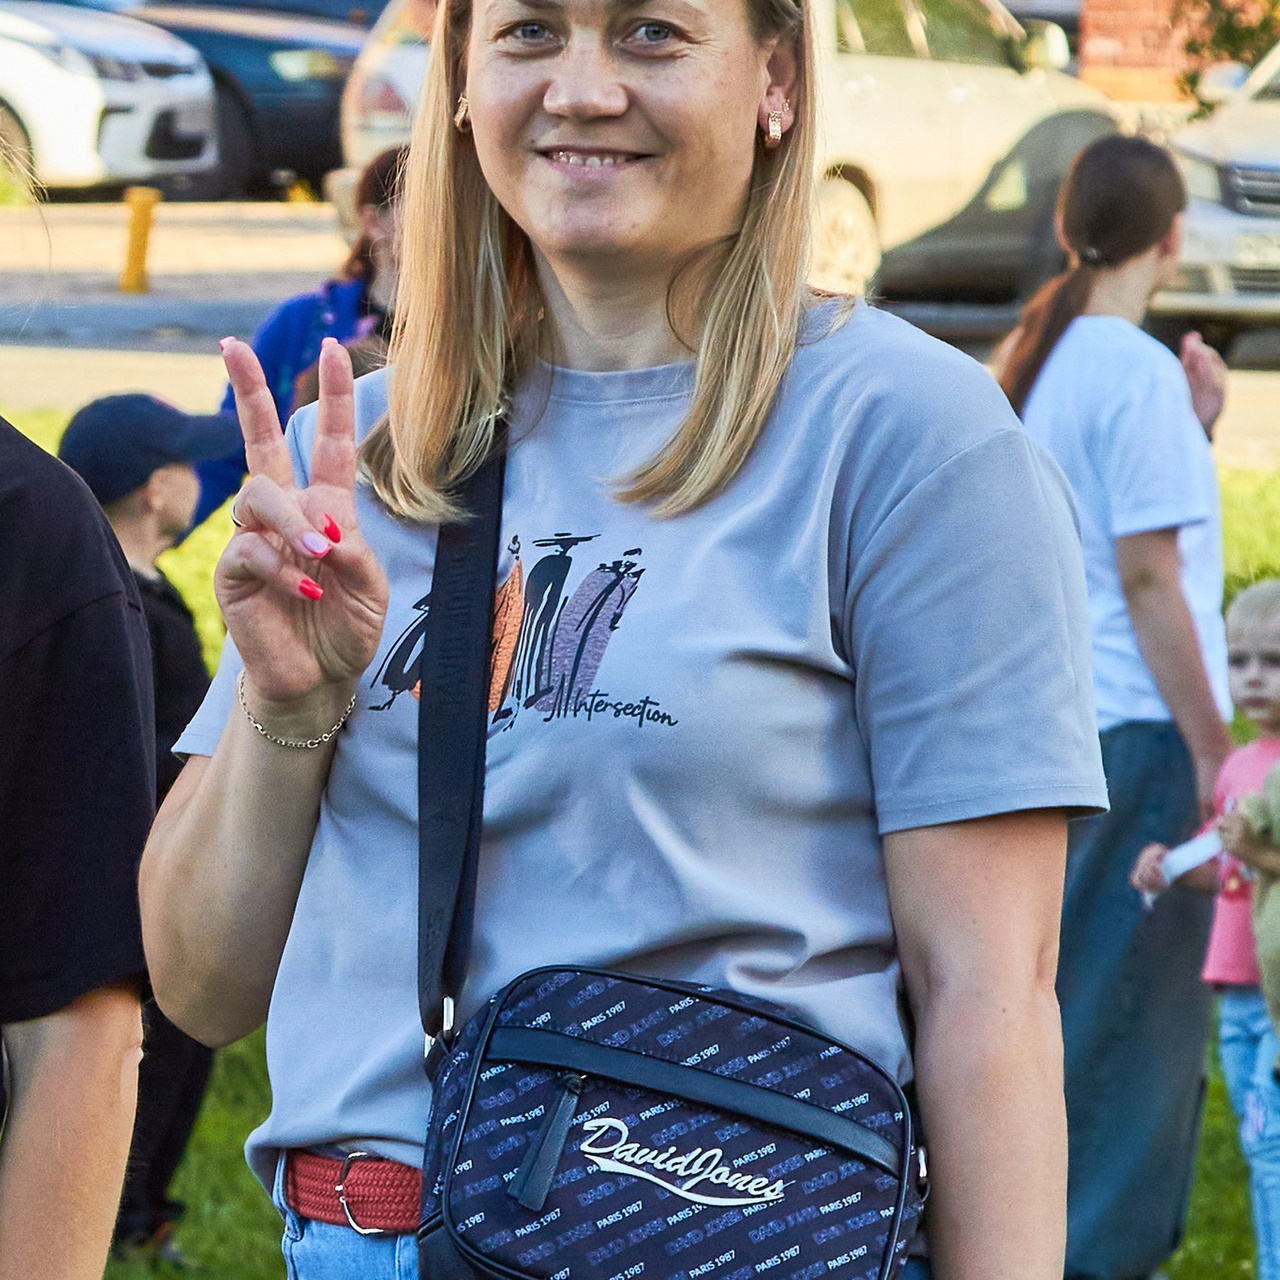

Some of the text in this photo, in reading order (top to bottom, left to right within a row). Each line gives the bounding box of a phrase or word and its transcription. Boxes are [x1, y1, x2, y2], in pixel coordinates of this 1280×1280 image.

[573, 688, 679, 728] Intersection
[581, 1012, 606, 1031] PARIS
[606, 1001, 626, 1020] 1987
[700, 1044, 719, 1060] 1987
[480, 1064, 506, 1082] PARIS
[591, 1100, 610, 1119] 1987
[852, 1093, 869, 1108] 1987
[500, 1114, 525, 1126] PARIS
[525, 1104, 545, 1121] 1987
[640, 1107, 665, 1121] PARIS
[733, 1143, 777, 1168] PARIS 1987
[596, 1212, 622, 1229] PARIS
[622, 1200, 643, 1220] 1987
[742, 1200, 768, 1218] PARIS
[819, 1201, 843, 1215] PARIS
[843, 1191, 862, 1208] 1987
[465, 1212, 485, 1228] 1987
[515, 1223, 541, 1237] PARIS
[540, 1208, 561, 1227] 1987
[666, 1207, 692, 1225] PARIS
[688, 1264, 715, 1279] PARIS
[714, 1250, 735, 1268] 1987
[755, 1257, 780, 1273] PARIS
[780, 1245, 800, 1263] 1987
[827, 1255, 850, 1270] PARIS
[849, 1245, 867, 1263] 1987
